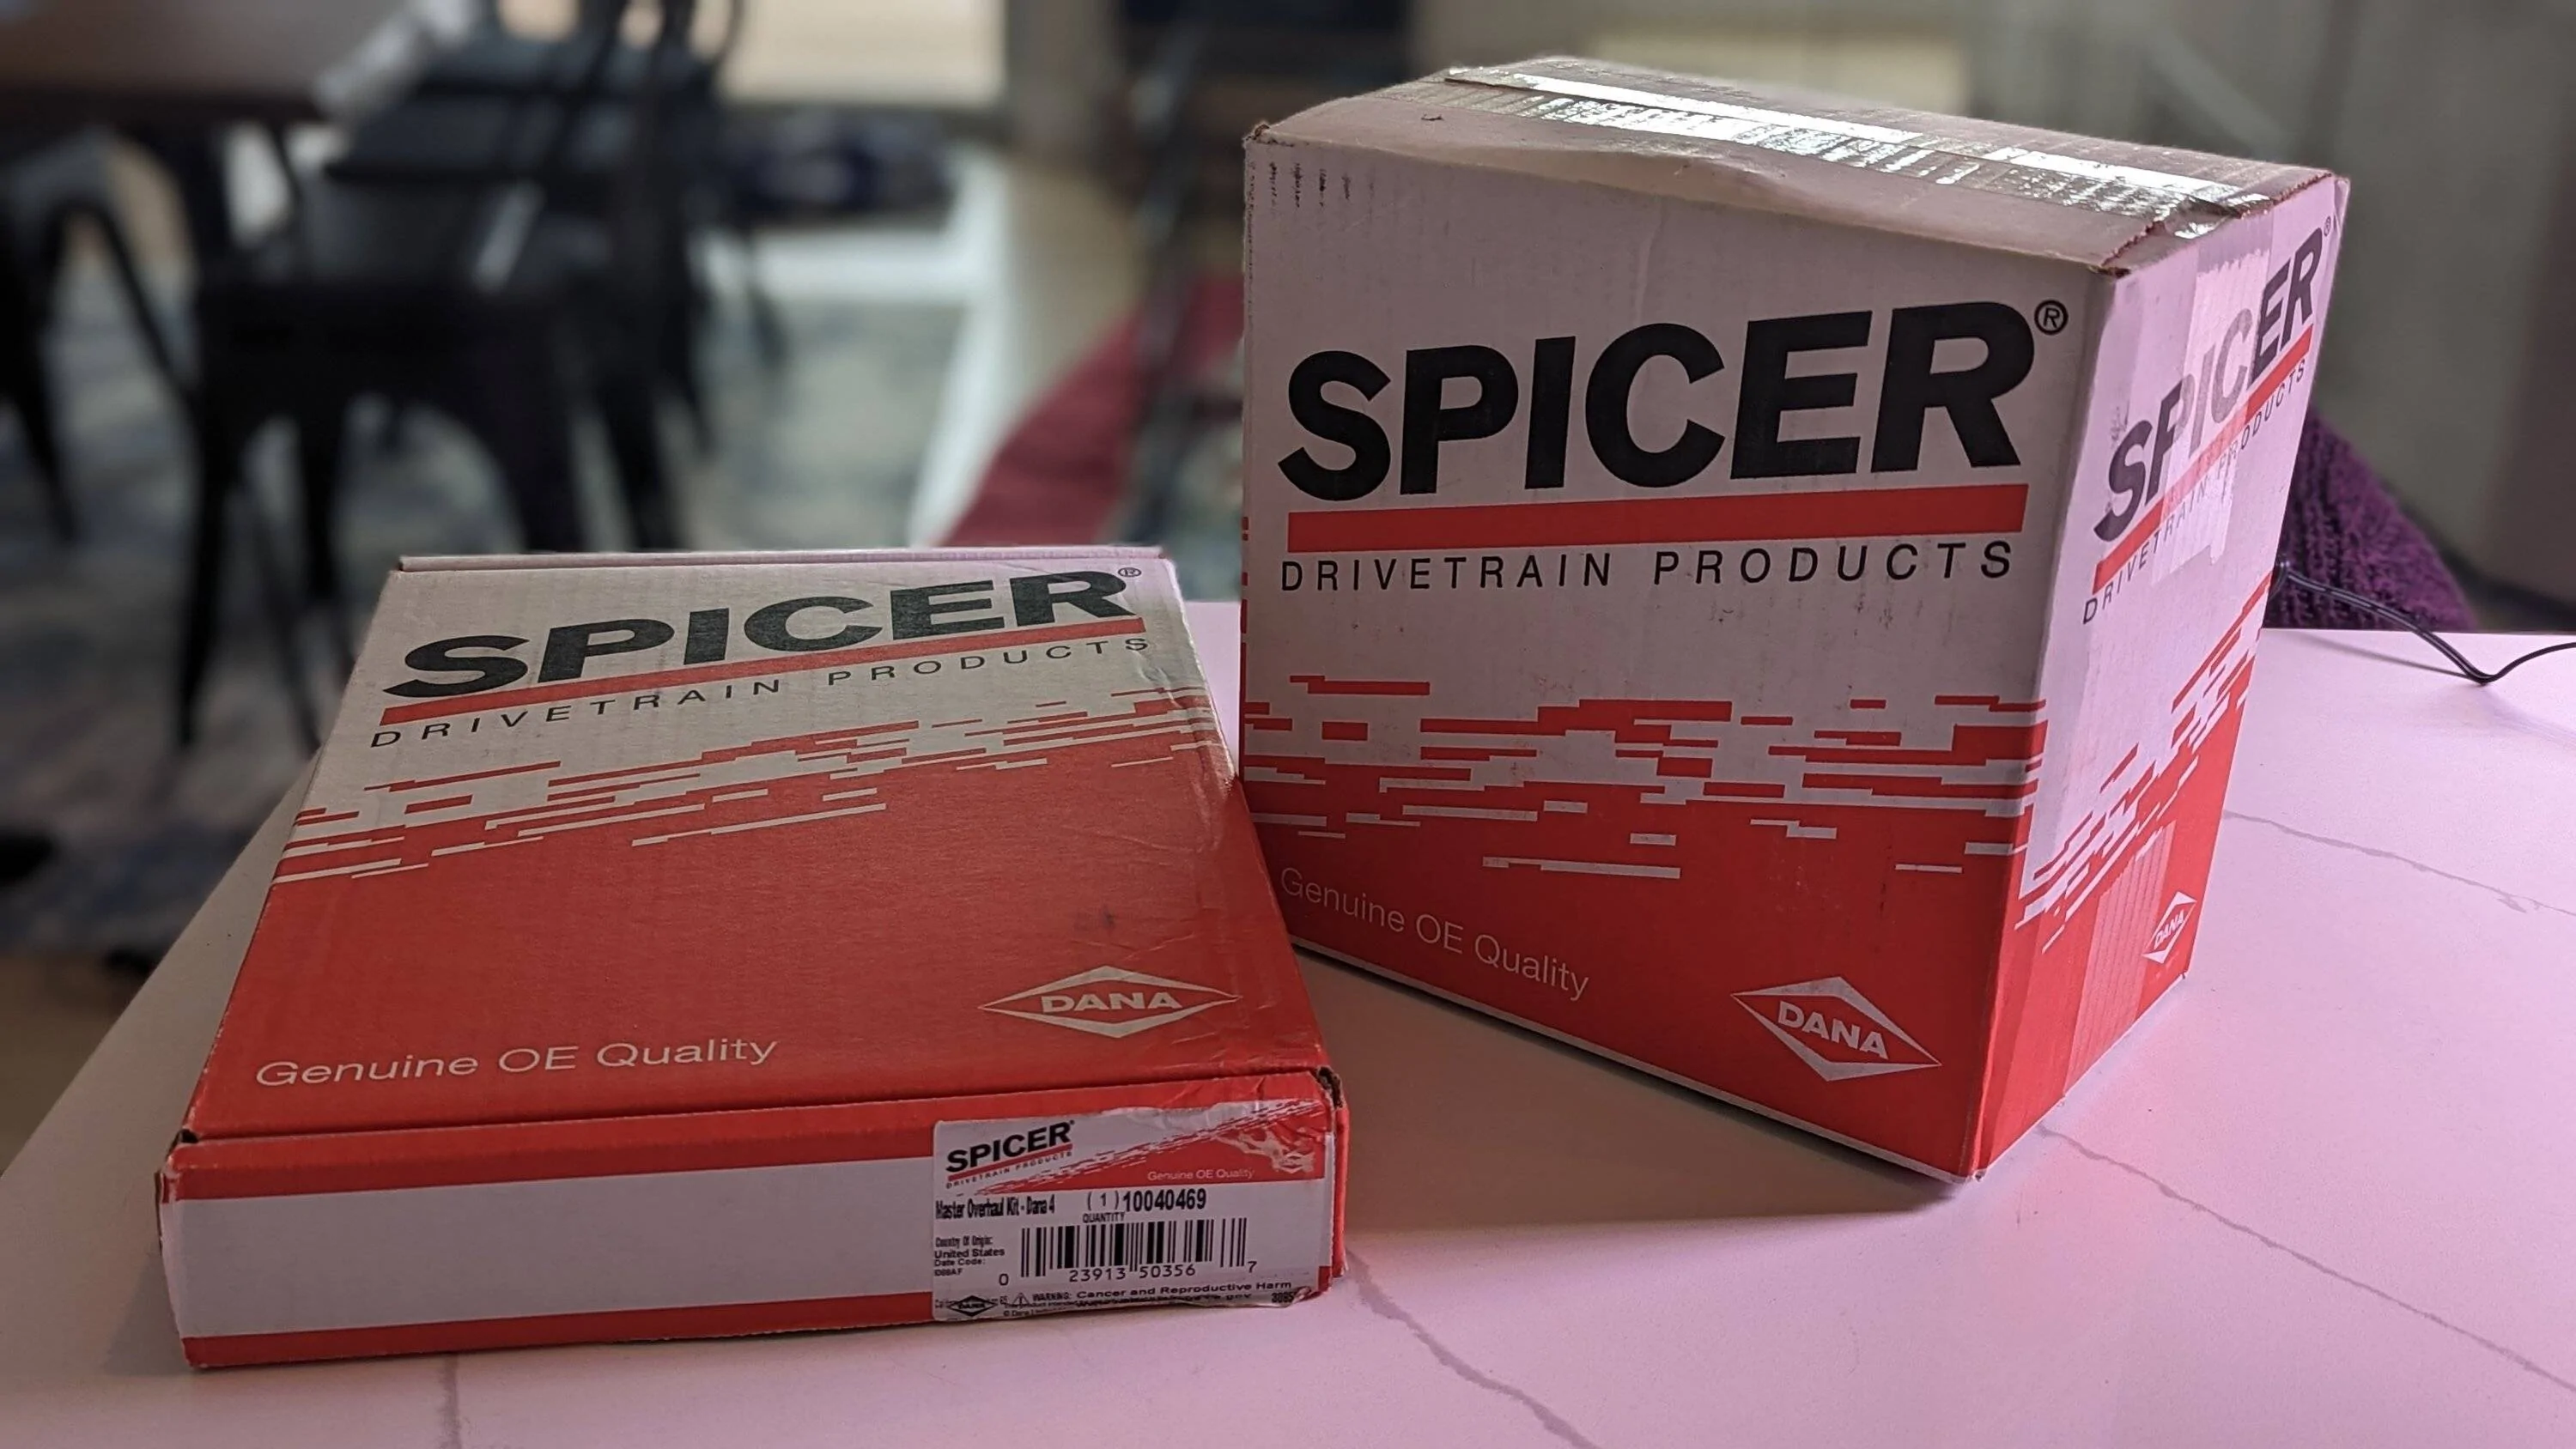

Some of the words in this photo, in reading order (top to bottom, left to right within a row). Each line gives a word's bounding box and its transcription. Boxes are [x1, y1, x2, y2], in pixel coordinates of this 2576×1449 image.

[2082, 475, 2208, 625] DRIVETRAIN
[2217, 359, 2306, 480] PRODUCTS
[1279, 552, 1611, 592] DRIVETRAIN
[1653, 540, 2014, 586] PRODUCTS
[370, 679, 780, 748] DRIVETRAIN
[828, 637, 1149, 686] PRODUCTS
[1280, 866, 1406, 933] Genuine
[1415, 913, 1464, 955] OE
[1474, 933, 1590, 1003] Quality
[2153, 908, 2184, 950] DANA
[1041, 991, 1183, 1014] DANA
[1777, 1000, 1889, 1060] DANA
[256, 1054, 479, 1087] Genuine
[498, 1046, 580, 1073] OE
[597, 1037, 778, 1067] Quality
[945, 1167, 1010, 1189] DRIVETRAIN
[1015, 1151, 1072, 1171] PRODUCTS
[1147, 1170, 1194, 1181] Genuine
[1195, 1168, 1214, 1179] OE
[1216, 1167, 1254, 1180] Quality
[1122, 1188, 1207, 1213] 10040469
[1083, 1211, 1126, 1224] QUANTITY
[934, 1250, 969, 1259] United
[971, 1248, 1005, 1258] States
[934, 1258, 956, 1267] Date
[1069, 1266, 1127, 1282] 23913
[1139, 1263, 1197, 1279] 50356
[1248, 1260, 1258, 1274] 7
[1076, 1289, 1126, 1299] Cancer
[1129, 1287, 1156, 1295] and
[1160, 1282, 1252, 1296] Reproductive
[1255, 1280, 1292, 1289] Harm
